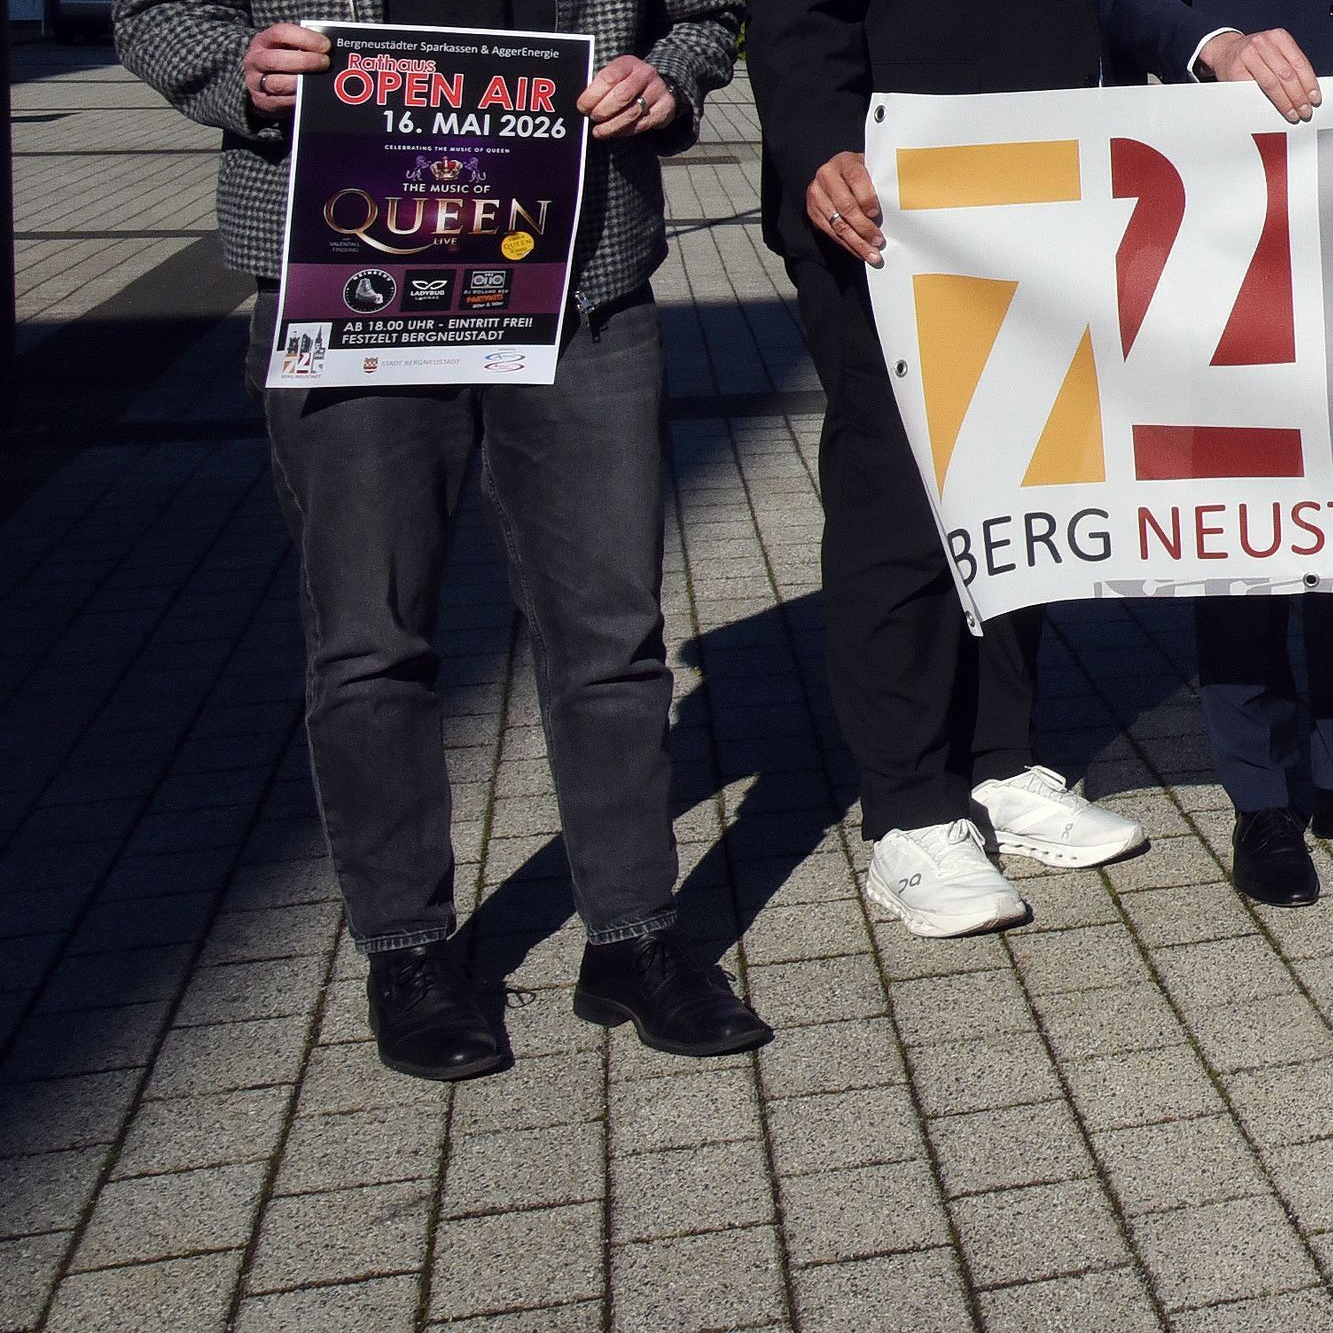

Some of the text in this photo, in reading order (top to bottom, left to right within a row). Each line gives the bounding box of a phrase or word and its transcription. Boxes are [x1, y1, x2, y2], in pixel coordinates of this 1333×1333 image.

[336, 37, 560, 60] Bergneustädter Sparkassen & AggerEnergie
[347, 53, 436, 73] Rathaus
[334, 69, 556, 113] OPEN AIR
[383, 110, 567, 139] 16. MAI 2026
[384, 144, 433, 152] CELEBRATING
[402, 182, 491, 194] THE MUSIC OF
[323, 188, 552, 255] QUEEN
[434, 236, 458, 246] LIVE
[410, 289, 445, 297] LADYBUG
[344, 321, 362, 332] AB
[370, 320, 403, 332] 18.00
[408, 319, 435, 330] UHR
[448, 318, 499, 330] EINTRITT
[502, 317, 533, 328] FREI!
[342, 330, 505, 345] FESTZELT BERGNEUSTADT
[404, 358, 461, 367] BERGNEUSTADT
[947, 507, 1112, 587] BERG
